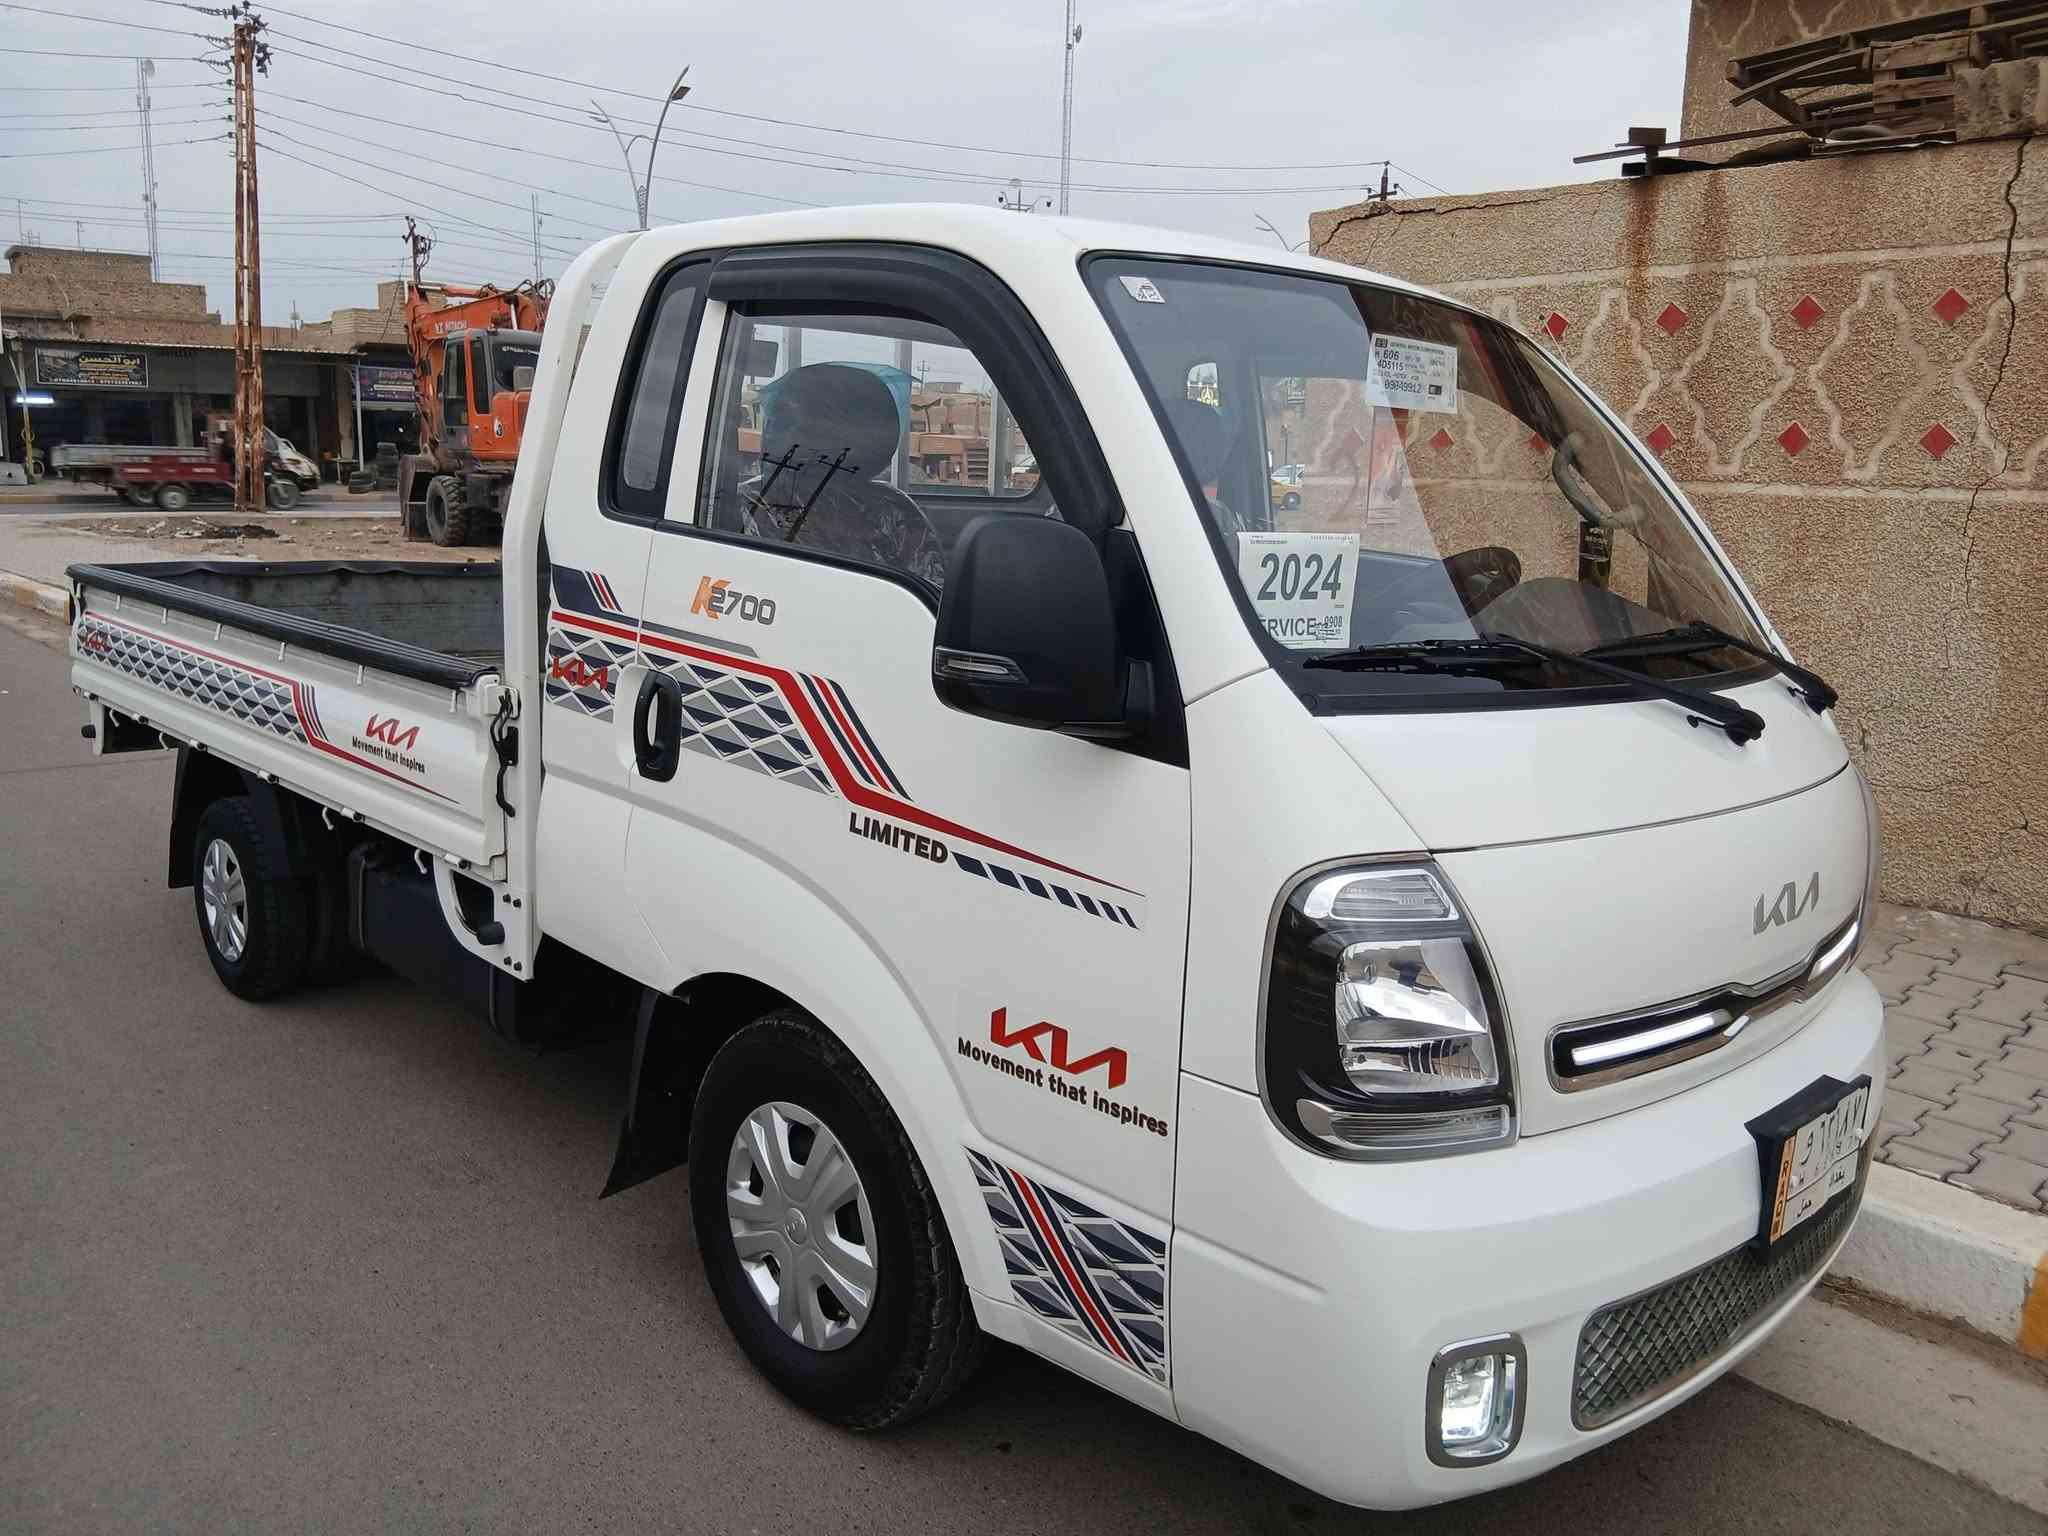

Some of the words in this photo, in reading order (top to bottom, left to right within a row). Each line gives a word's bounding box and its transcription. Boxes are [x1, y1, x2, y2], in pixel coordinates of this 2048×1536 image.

[690, 575, 776, 625] K2700
[1257, 552, 1343, 601] 2024
[1261, 618, 1317, 637] RVICE
[552, 655, 608, 689] KIA
[352, 735, 384, 758] Movement
[384, 745, 399, 764] that
[400, 753, 425, 774] inspires
[366, 713, 420, 751] KIA
[849, 811, 949, 864] LIMITED
[1753, 871, 1819, 935] KIA
[991, 1006, 1128, 1090] KIA
[957, 1037, 1044, 1088] Movement
[1048, 1074, 1087, 1106] that
[1093, 1090, 1168, 1138] inspires
